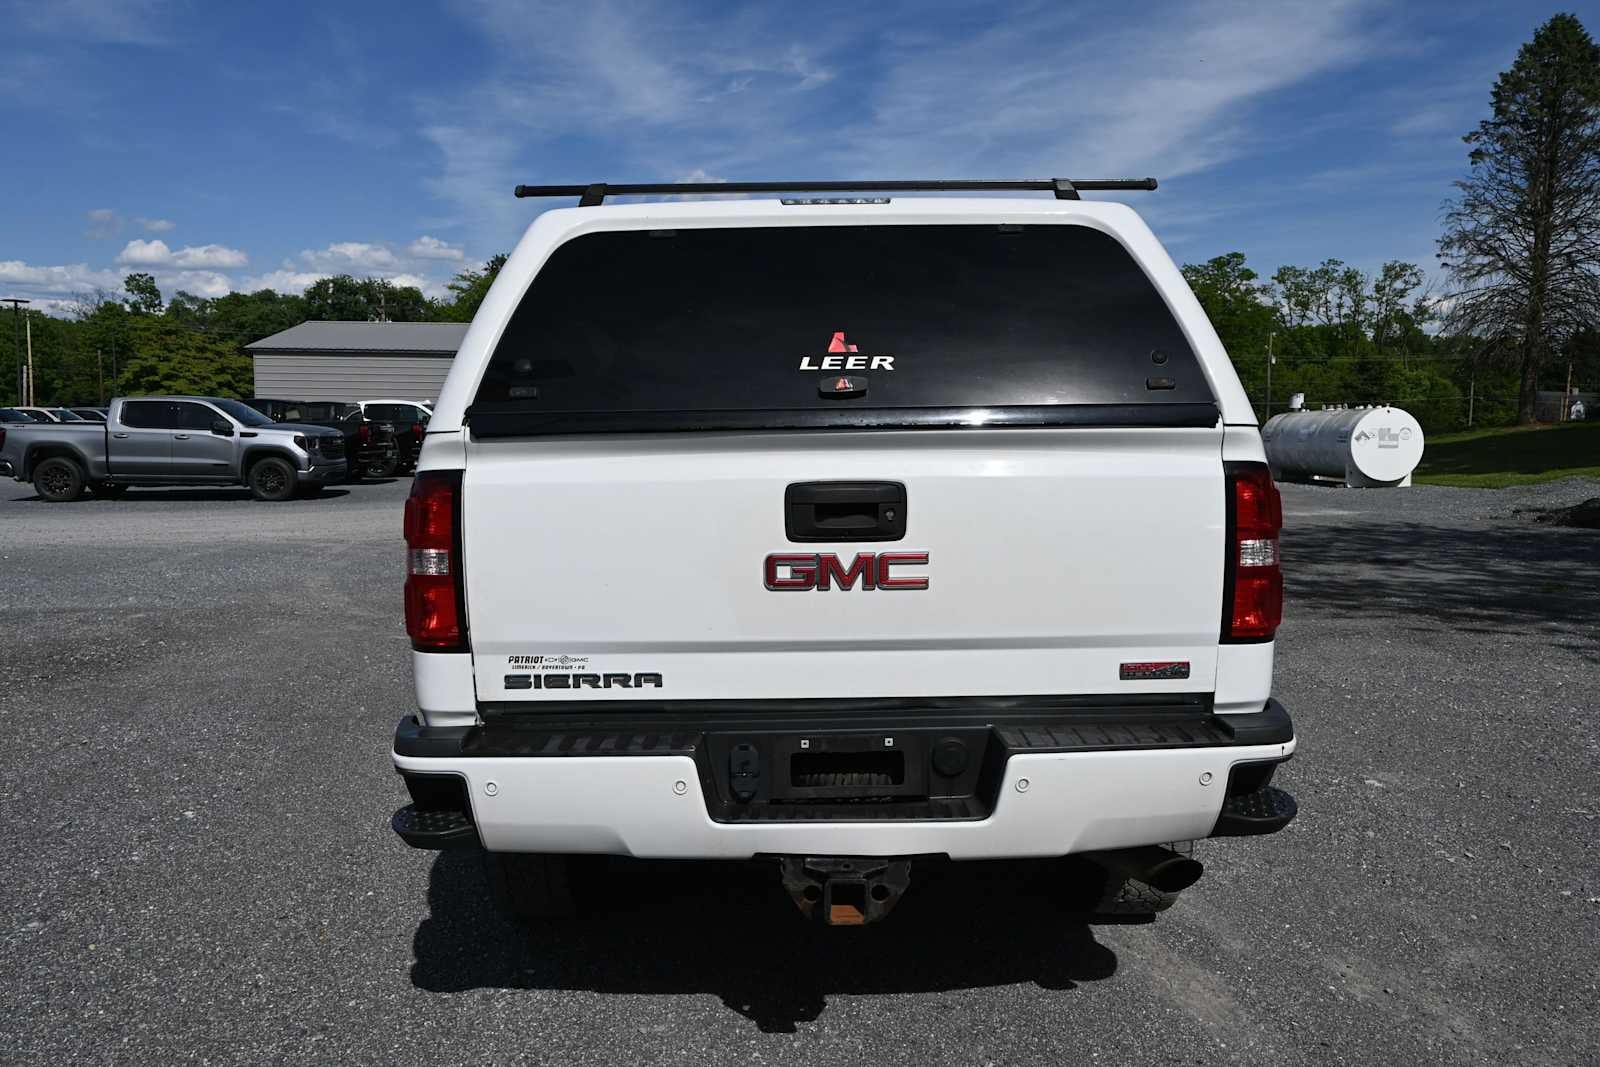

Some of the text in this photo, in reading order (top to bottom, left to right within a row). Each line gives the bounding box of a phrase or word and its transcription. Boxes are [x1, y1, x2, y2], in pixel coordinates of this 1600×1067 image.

[799, 355, 895, 371] LEER
[764, 552, 929, 591] GMC
[508, 655, 544, 664] PATRIOT
[504, 673, 663, 689] SIERRA
